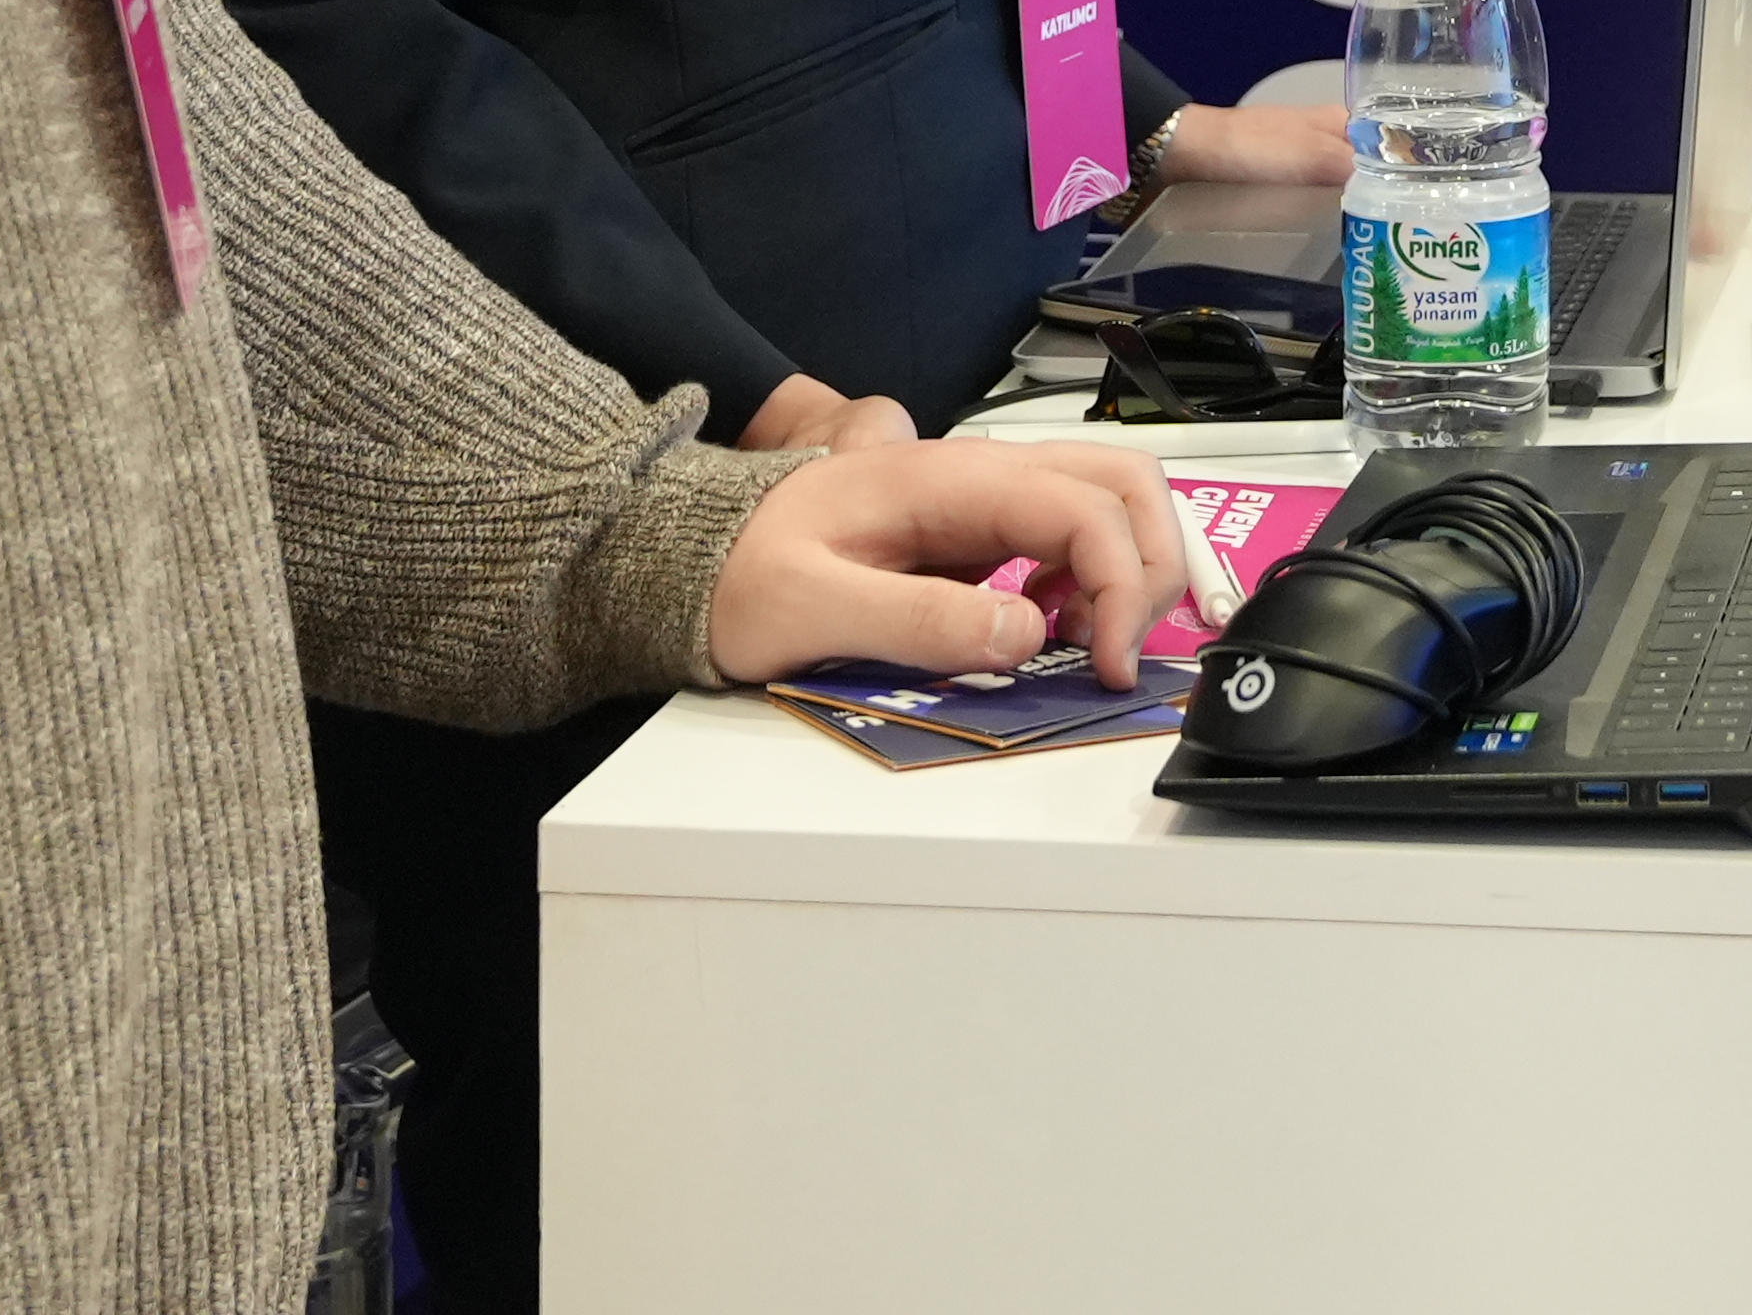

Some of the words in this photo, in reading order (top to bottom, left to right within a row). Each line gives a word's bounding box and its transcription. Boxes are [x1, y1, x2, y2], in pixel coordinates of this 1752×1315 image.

[1349, 221, 1376, 354] ULUDAĞ
[1412, 290, 1478, 306] yaşam
[1208, 488, 1276, 549] EVENT
